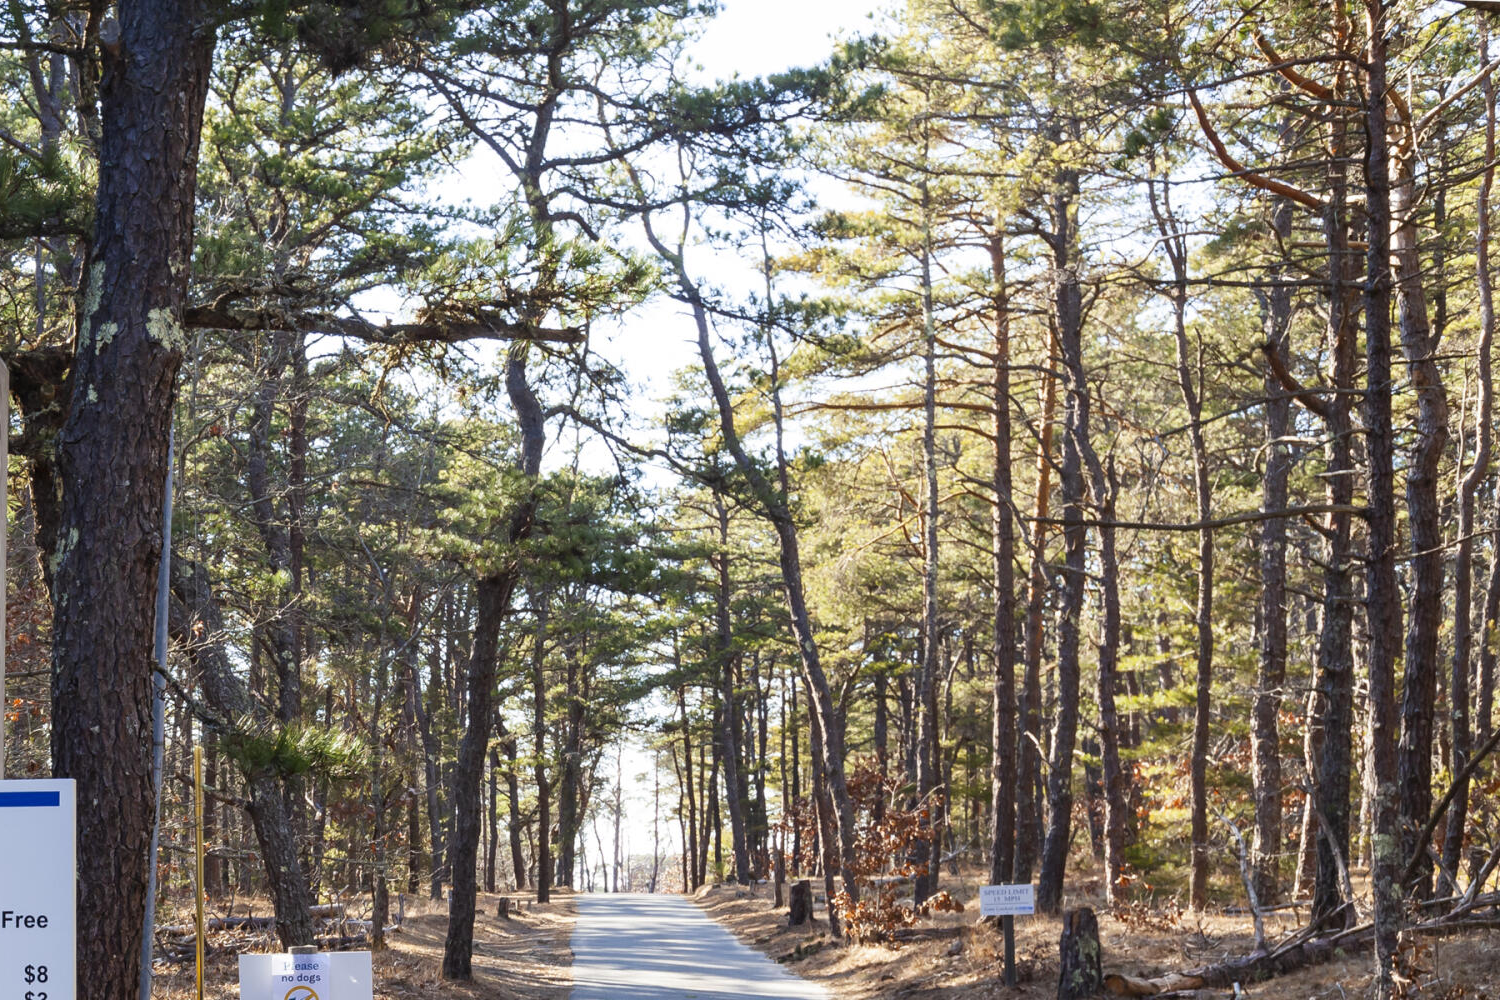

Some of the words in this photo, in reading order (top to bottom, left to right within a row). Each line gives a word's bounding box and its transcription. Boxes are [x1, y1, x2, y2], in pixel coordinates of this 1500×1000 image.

[2, 911, 48, 928] Free
[24, 964, 48, 985] $8
[297, 973, 321, 984] dogs
